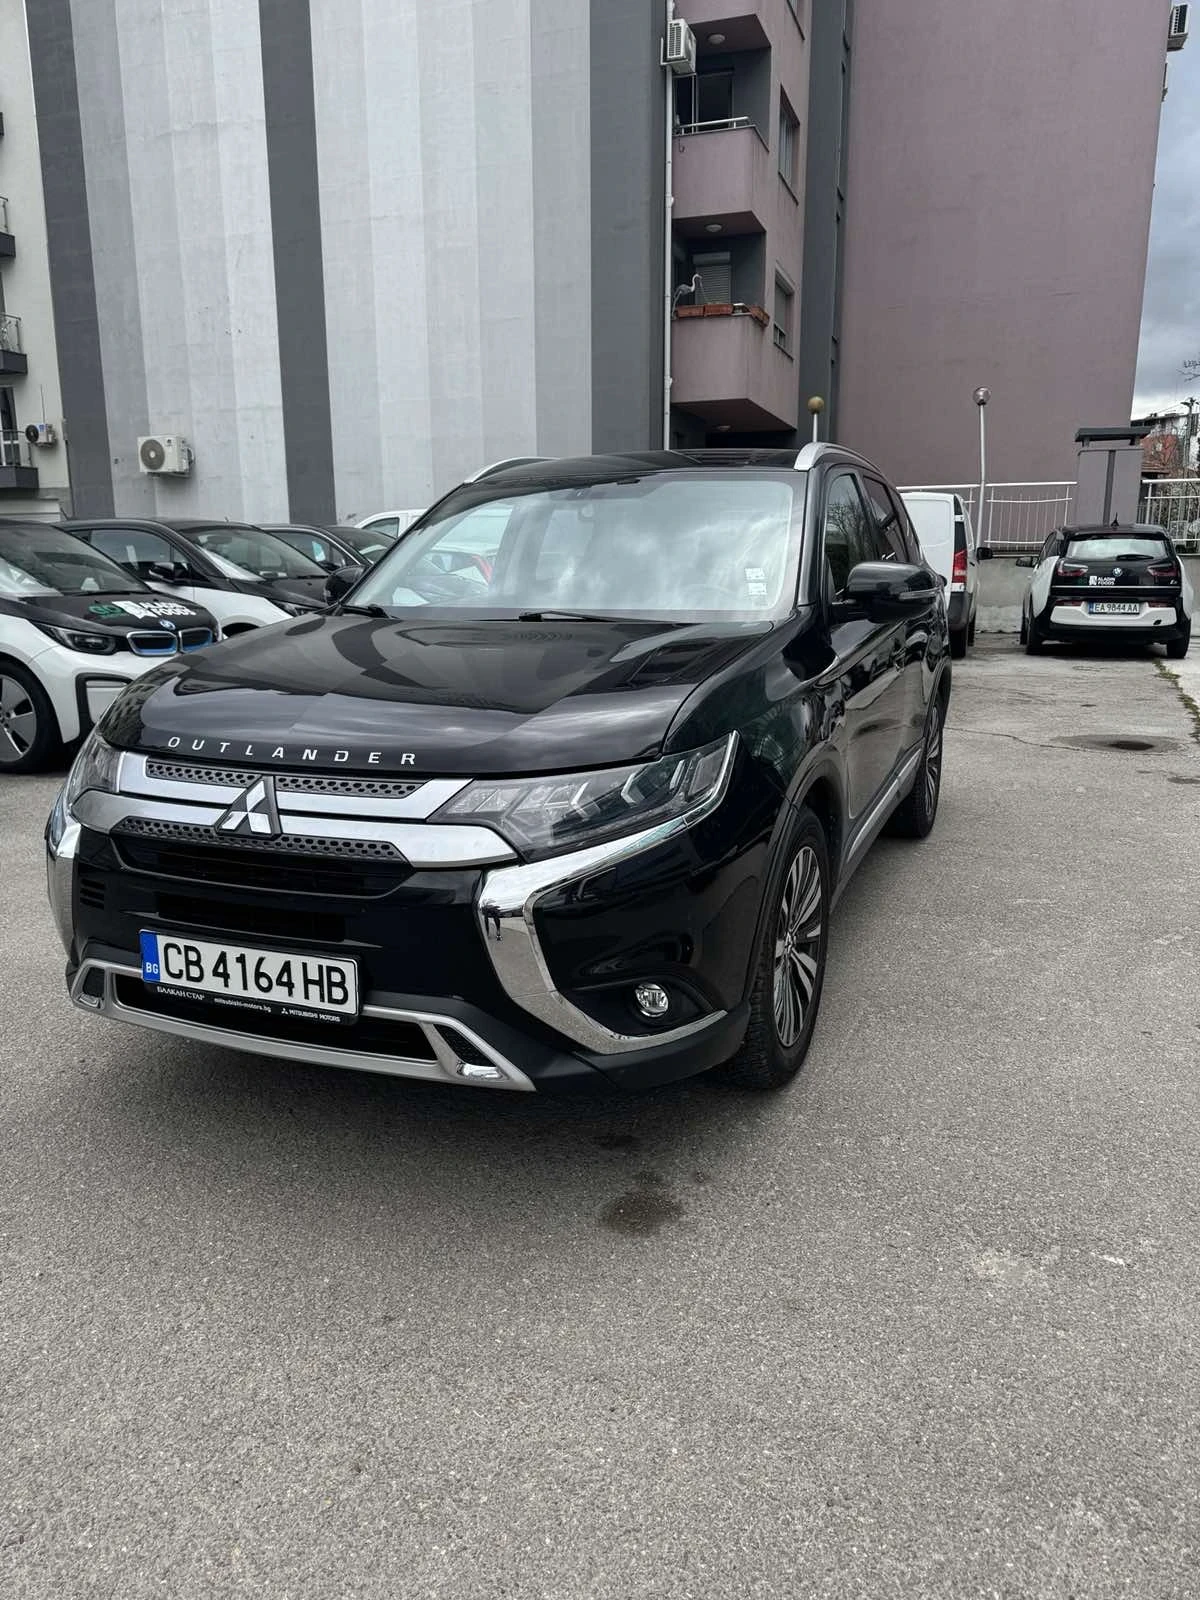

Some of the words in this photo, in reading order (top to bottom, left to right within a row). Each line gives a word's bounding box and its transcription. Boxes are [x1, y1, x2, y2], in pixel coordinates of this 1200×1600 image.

[167, 736, 416, 765] OUTLANDER
[146, 961, 159, 974] BG
[211, 951, 295, 997] 4164
[288, 1008, 318, 1019] MITSUBISHI
[319, 1013, 341, 1022] MOTORS
